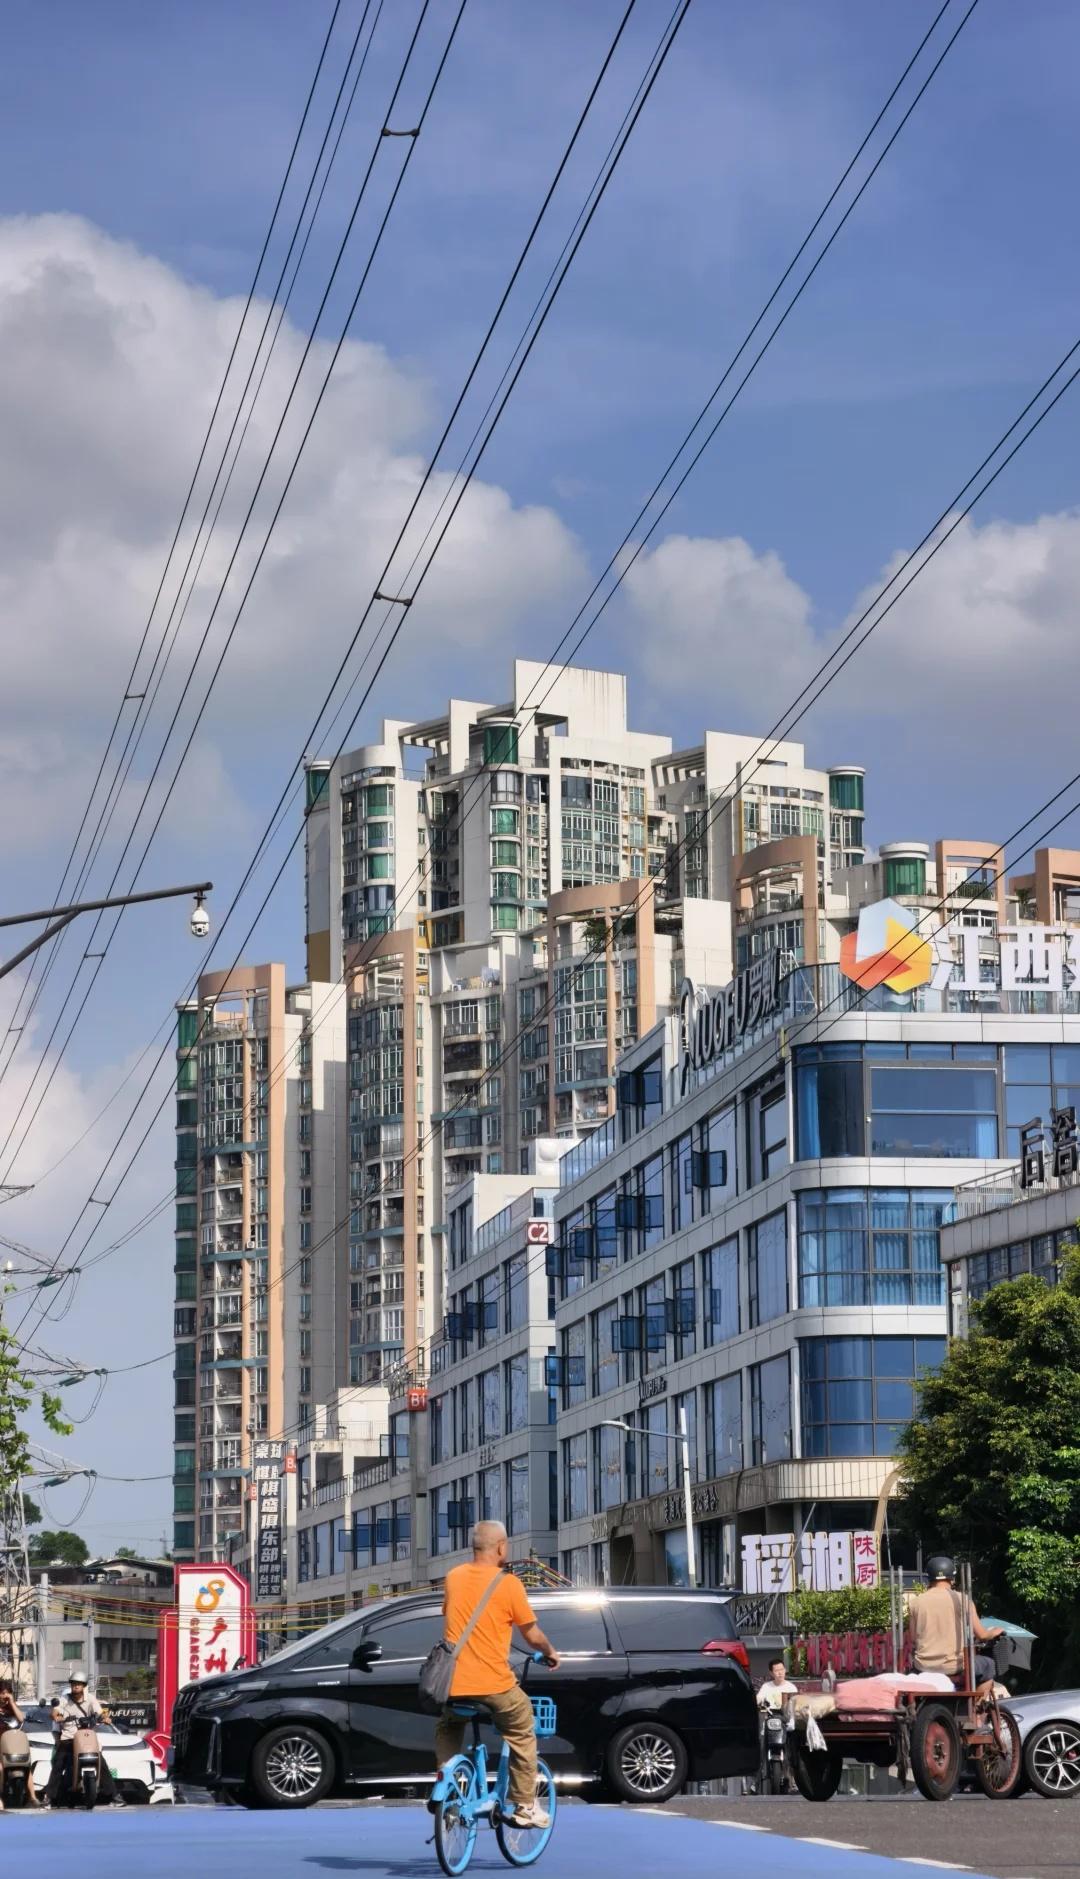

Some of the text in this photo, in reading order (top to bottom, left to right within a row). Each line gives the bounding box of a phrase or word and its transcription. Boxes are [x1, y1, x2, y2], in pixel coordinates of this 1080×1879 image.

[930, 924, 1080, 991] 江西
[527, 1223, 549, 1242] C2
[411, 1392, 425, 1408] B1
[741, 1532, 877, 1595] 稻湘 味厨
